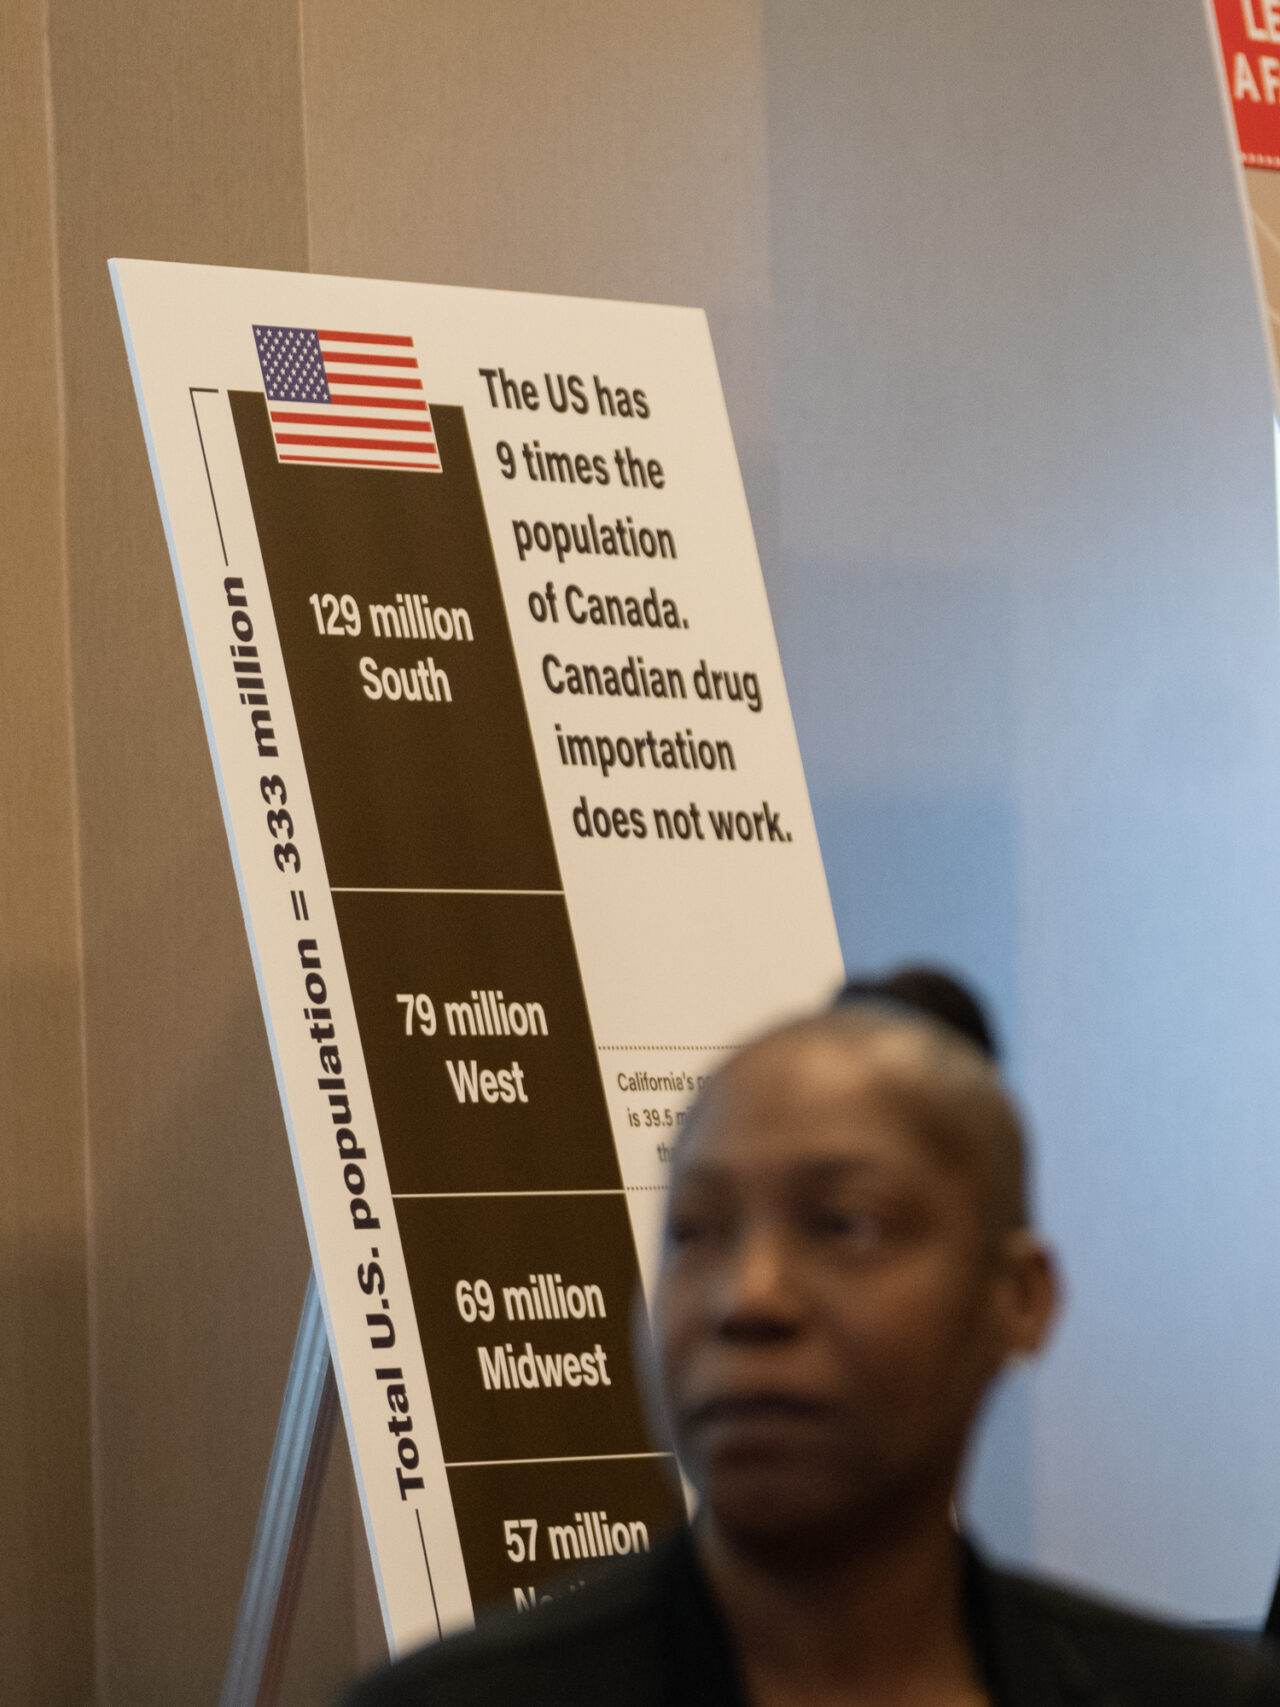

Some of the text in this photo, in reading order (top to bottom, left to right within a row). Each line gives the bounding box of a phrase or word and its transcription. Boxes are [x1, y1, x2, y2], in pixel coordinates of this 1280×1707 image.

[1233, 52, 1261, 101] A
[478, 367, 650, 420] The US has
[495, 440, 665, 490] 9 times the
[511, 513, 677, 564] population
[309, 593, 474, 642] 129 million
[528, 581, 689, 629] of Canada.
[359, 656, 453, 702] South
[542, 653, 763, 713] Canadian drug
[554, 723, 736, 778] importation
[572, 796, 792, 842] does not work.
[396, 990, 549, 1037] 79 million
[223, 576, 425, 1501] Total U.S. population = 333 million
[445, 1059, 529, 1104] West
[616, 1070, 695, 1093] California's
[626, 1106, 641, 1128] is
[642, 1108, 674, 1128] 39.5
[455, 1273, 607, 1323] 69 million
[477, 1342, 612, 1390] Midwest
[503, 1510, 649, 1563] 57 million
